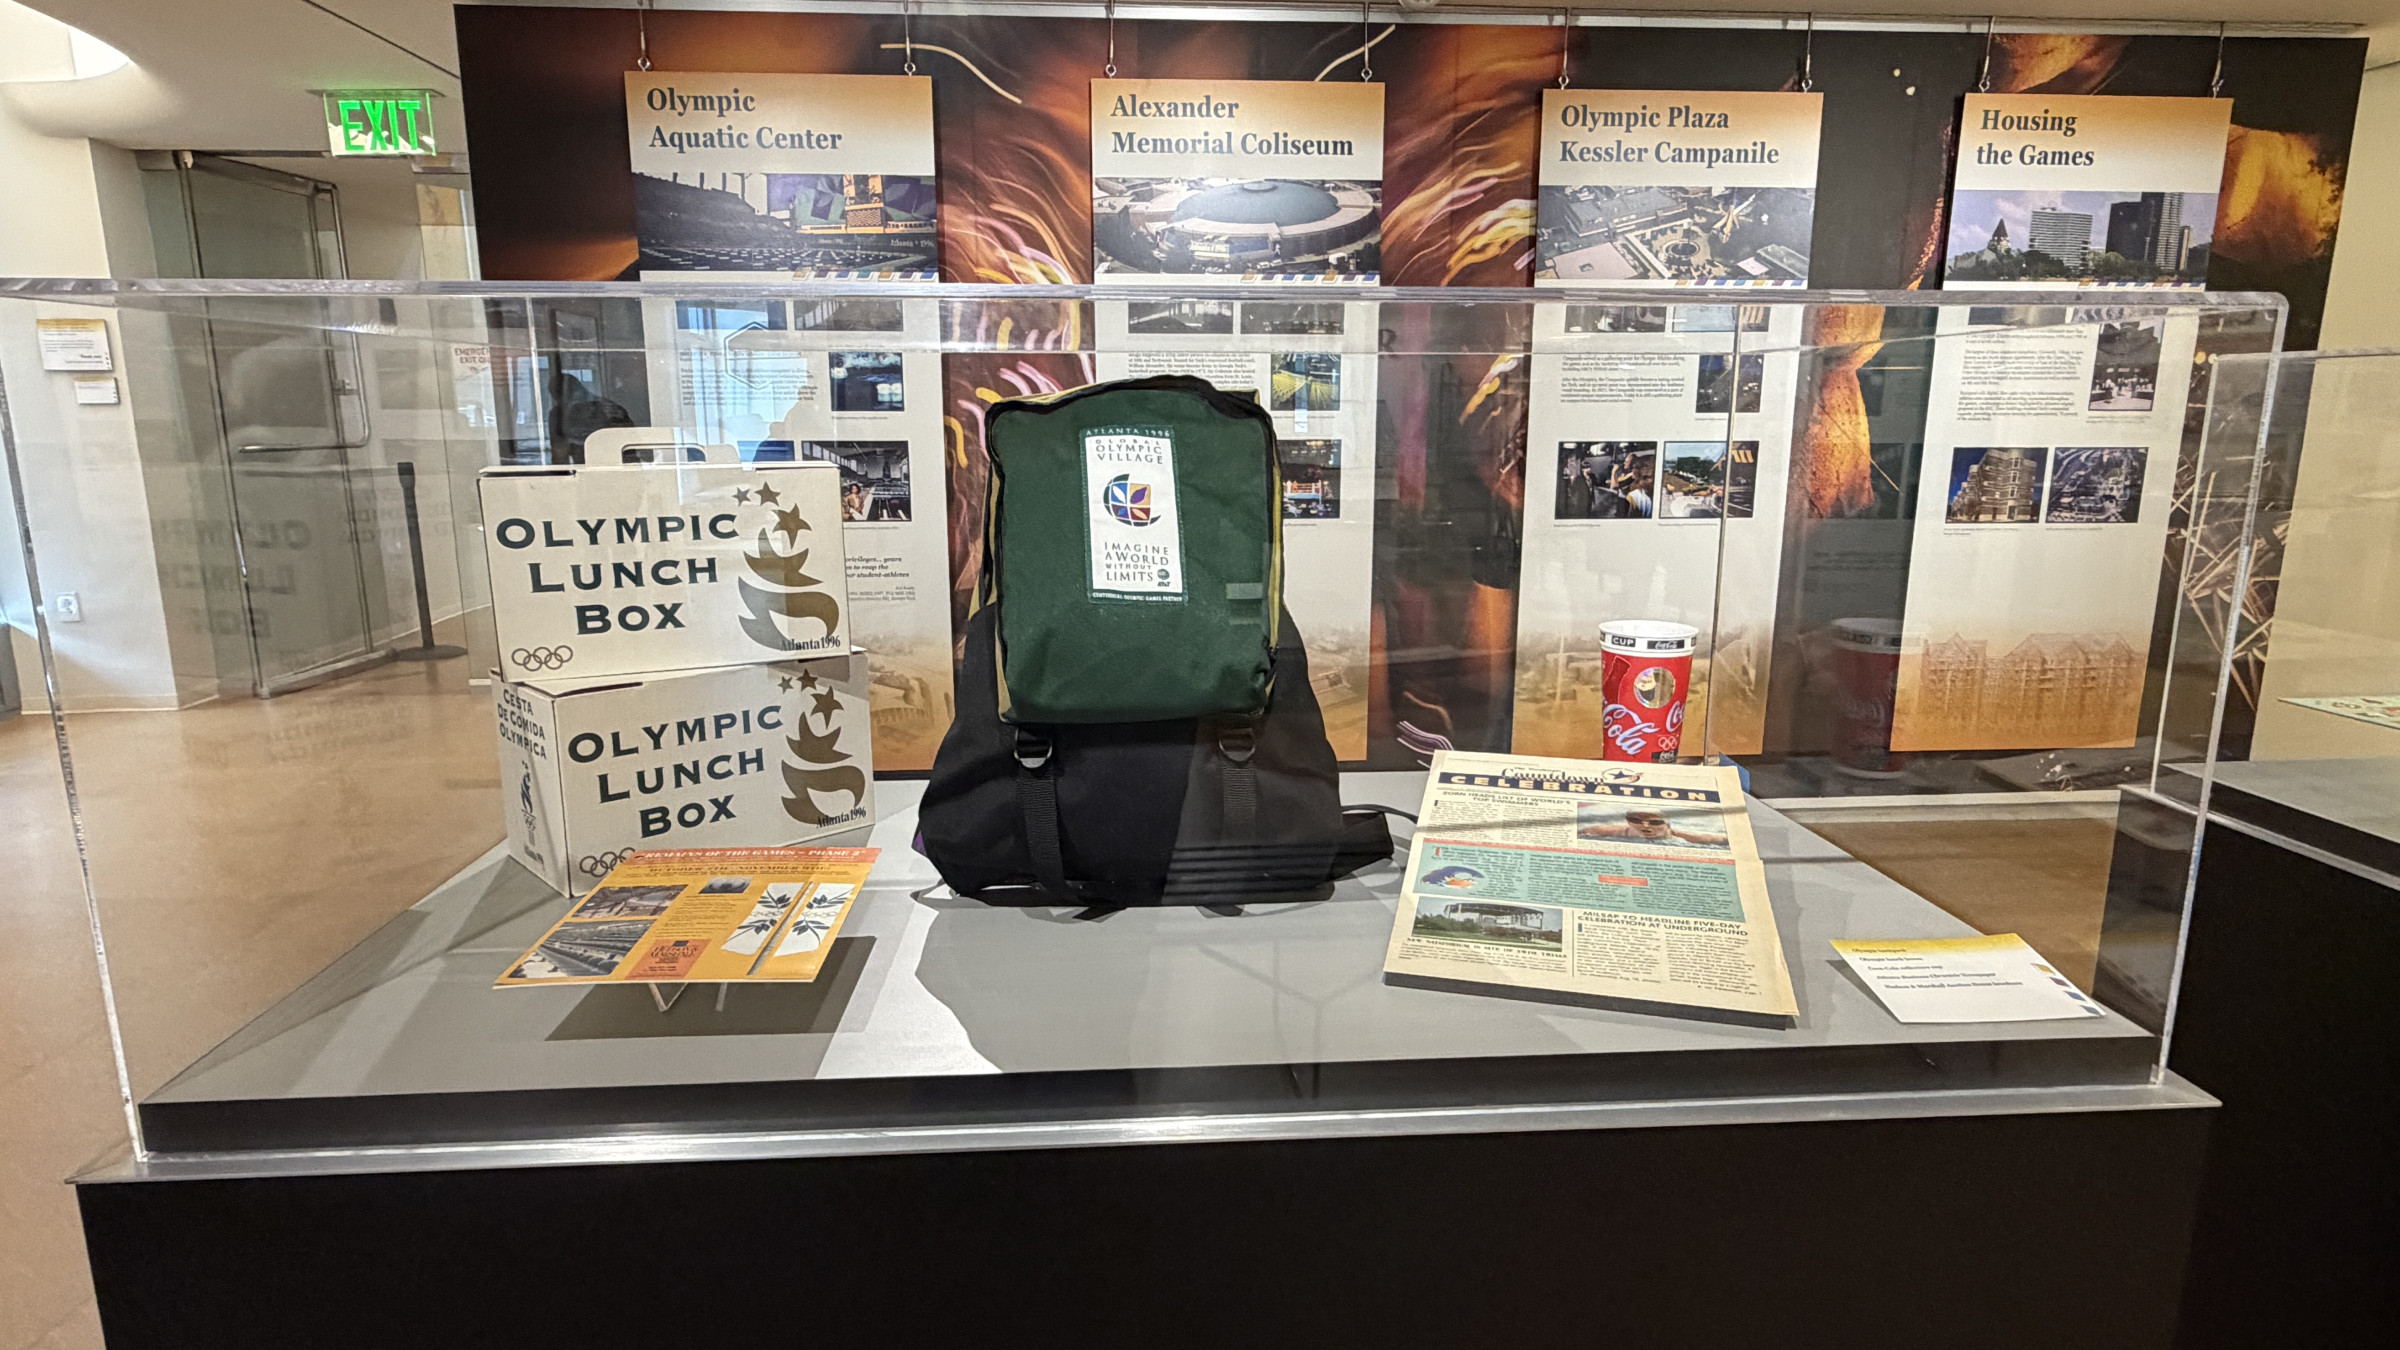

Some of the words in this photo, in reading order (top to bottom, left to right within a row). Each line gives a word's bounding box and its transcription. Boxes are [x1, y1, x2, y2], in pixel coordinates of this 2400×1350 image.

[647, 87, 756, 117] Olympic
[1110, 94, 1240, 118] Alexander
[338, 100, 421, 151] EXIT
[1561, 104, 1661, 133] Olympic
[1666, 105, 1730, 129] Plaza
[1980, 108, 2078, 138] Housing
[649, 125, 750, 153] Aquatic
[756, 126, 843, 150] Center
[1111, 131, 1233, 155] Memorial
[1240, 132, 1354, 156] Coliseum
[1559, 140, 1649, 163] Kessler
[1654, 141, 1780, 168] Campanile
[1976, 143, 2013, 165] the
[2019, 144, 2095, 167] Games
[1086, 428, 1140, 436] ATLANTA
[1145, 429, 1170, 437] 1996
[1095, 444, 1162, 455] OLYMPIC
[1097, 453, 1163, 465] VILLAGE
[496, 513, 740, 550] OLYMPIC
[1104, 541, 1169, 555] IMAGINE
[1105, 551, 1113, 561] A
[1115, 551, 1169, 566] WORLD
[527, 557, 719, 593] LUNCH
[1106, 571, 1154, 582] LIMITS
[574, 602, 687, 635] BOX
[780, 638, 820, 651] Atlanta
[820, 634, 841, 649] 1996
[1612, 637, 1634, 646] CUP
[503, 688, 533, 716] CESTA
[497, 703, 508, 722] DE
[509, 710, 545, 740] COMIDA
[568, 705, 784, 763] OLYMPIC
[499, 722, 547, 760] OLYMPICA
[597, 747, 765, 804] LUNCH
[1450, 775, 1707, 801] CELEBRATION
[1501, 768, 1604, 785] Countdown
[638, 794, 737, 839] BOX
[816, 812, 849, 829] Atlanta
[850, 806, 867, 821] 1996
[1577, 916, 1646, 927] CELEBRATION
[1664, 923, 1749, 936] UNDERGROUND
[1582, 911, 1622, 919] MILSAP
[1640, 916, 1692, 925] HEADLINE
[1693, 920, 1741, 929] FIVE-DAY
